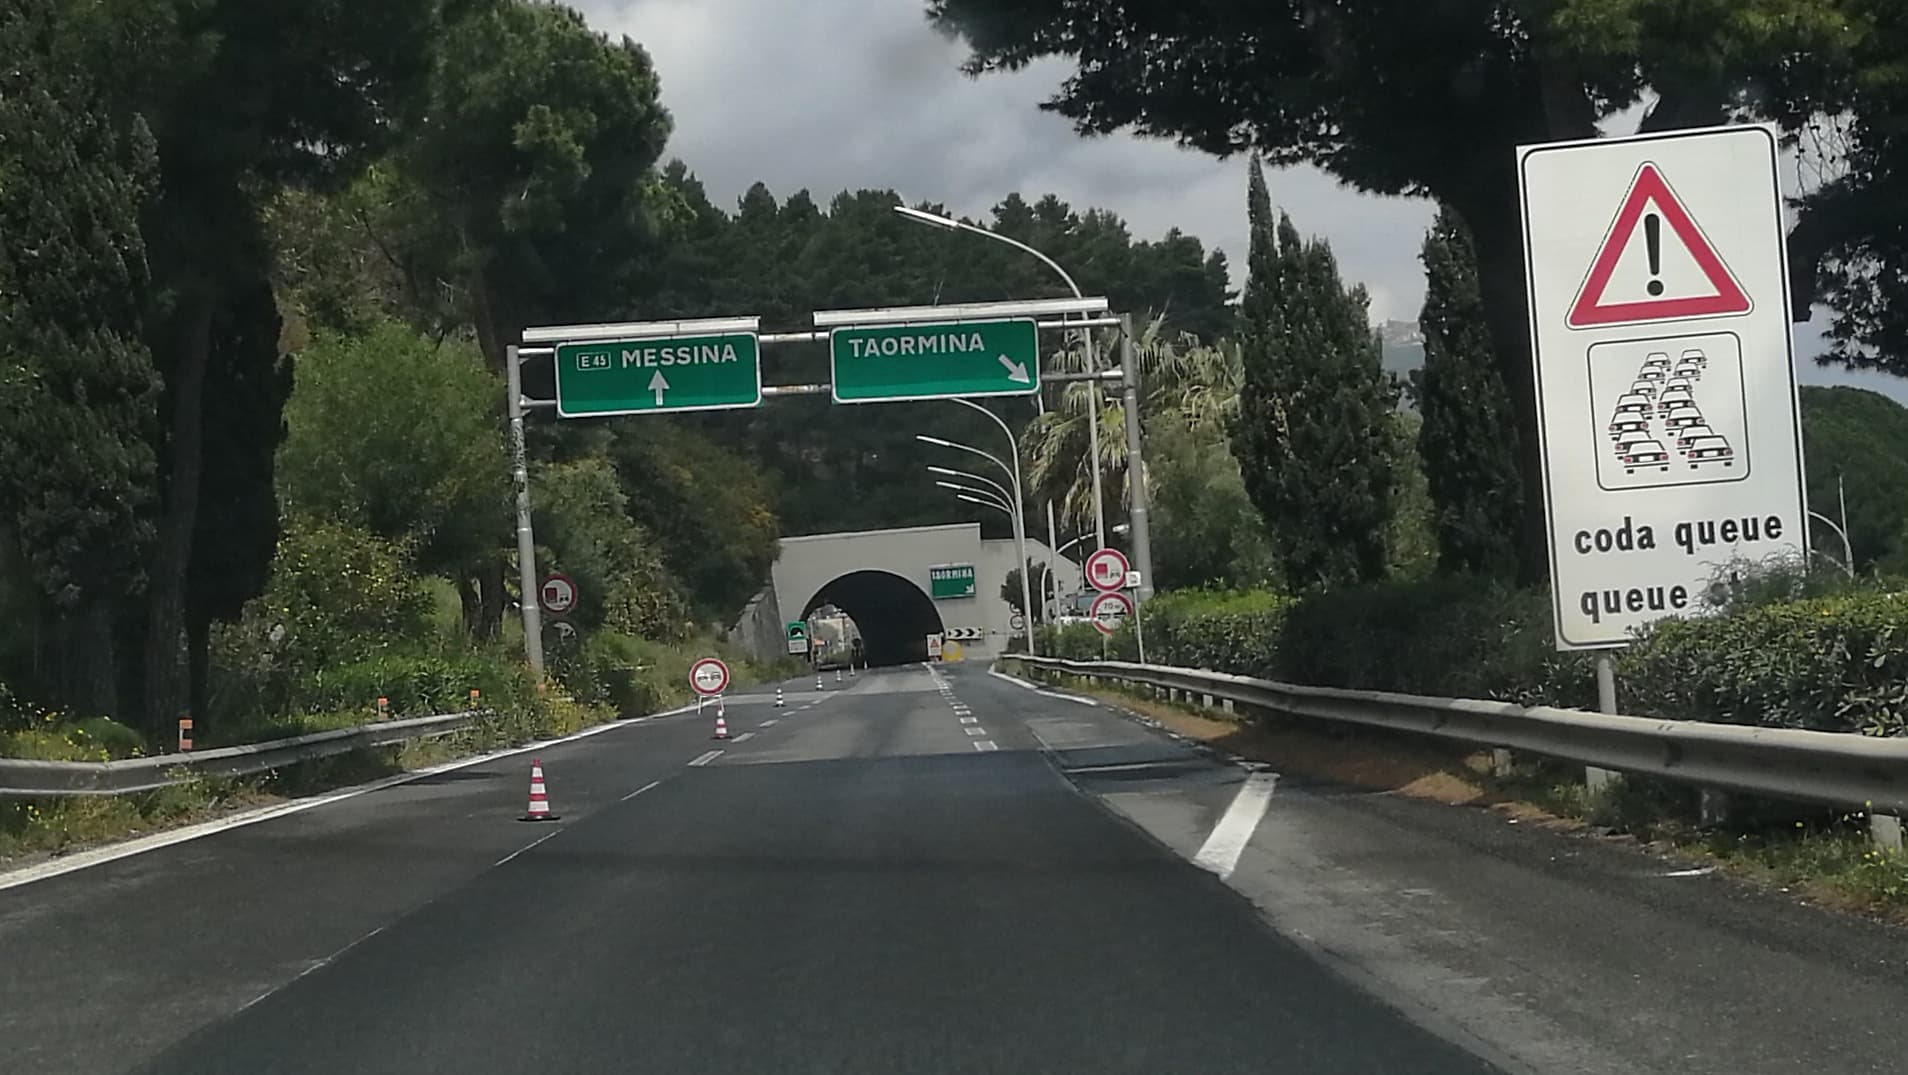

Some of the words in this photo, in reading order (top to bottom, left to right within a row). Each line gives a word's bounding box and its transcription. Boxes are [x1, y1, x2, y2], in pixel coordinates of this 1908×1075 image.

[621, 343, 738, 369] MESSINA
[848, 332, 985, 358] TAORMINA
[1574, 516, 1656, 555] coda
[1674, 515, 1783, 555] queue
[1580, 585, 1688, 624] queue
